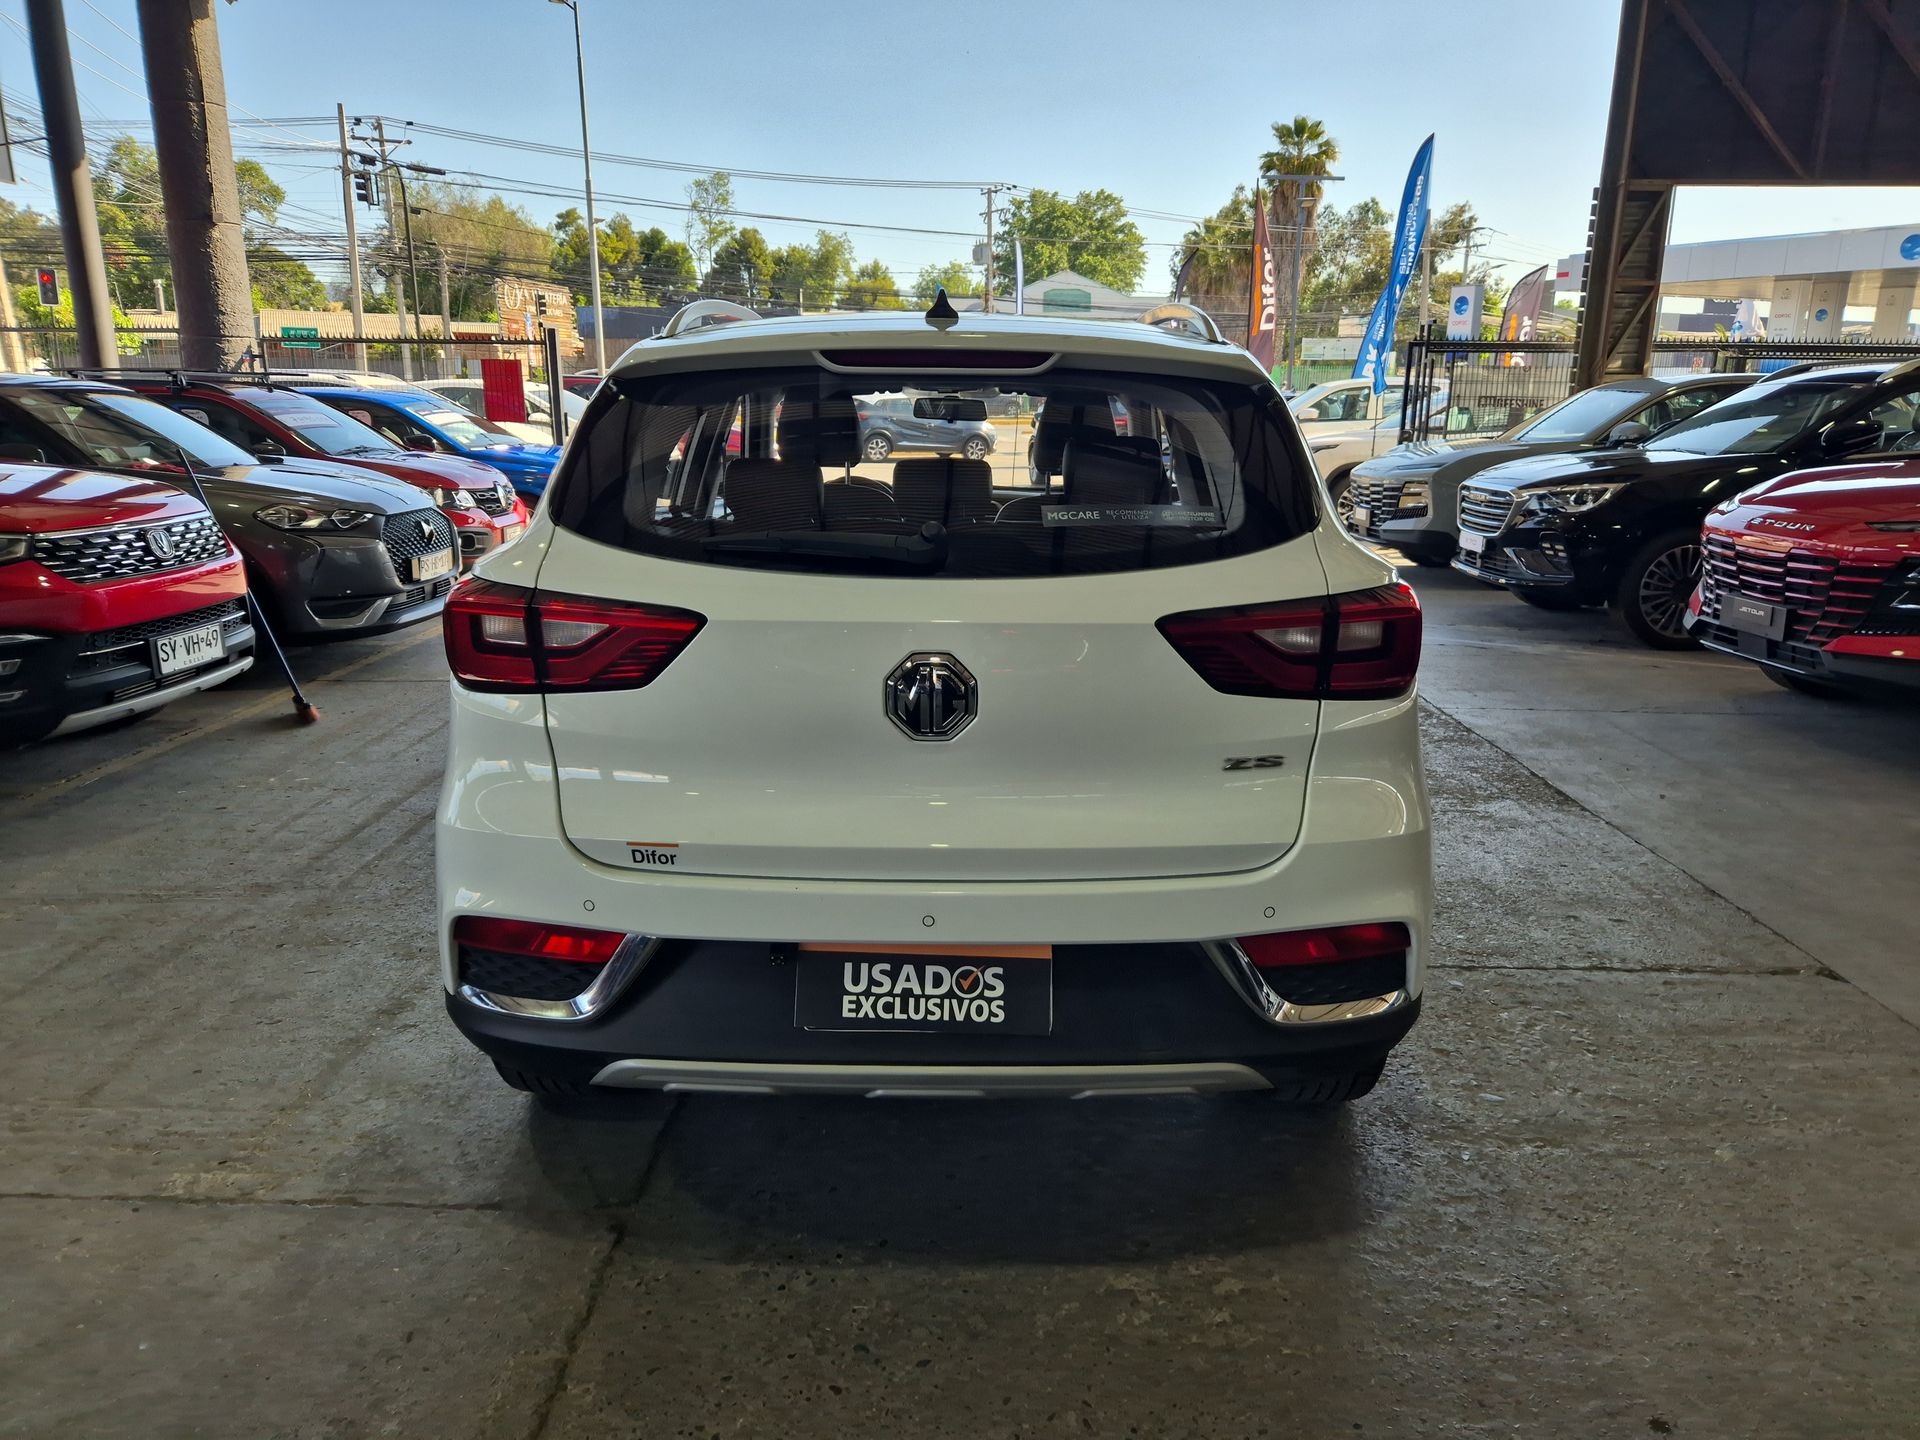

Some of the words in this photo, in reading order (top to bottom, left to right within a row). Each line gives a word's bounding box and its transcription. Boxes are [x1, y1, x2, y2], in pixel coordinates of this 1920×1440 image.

[1260, 247, 1275, 331] Difor
[1048, 511, 1100, 520] MGCARE
[1739, 606, 1765, 617] JETOUR
[1222, 754, 1286, 771] ZS
[631, 848, 678, 865] Difor
[843, 962, 1005, 998] USADOS
[842, 995, 1005, 1023] EXCLUSIVOS
